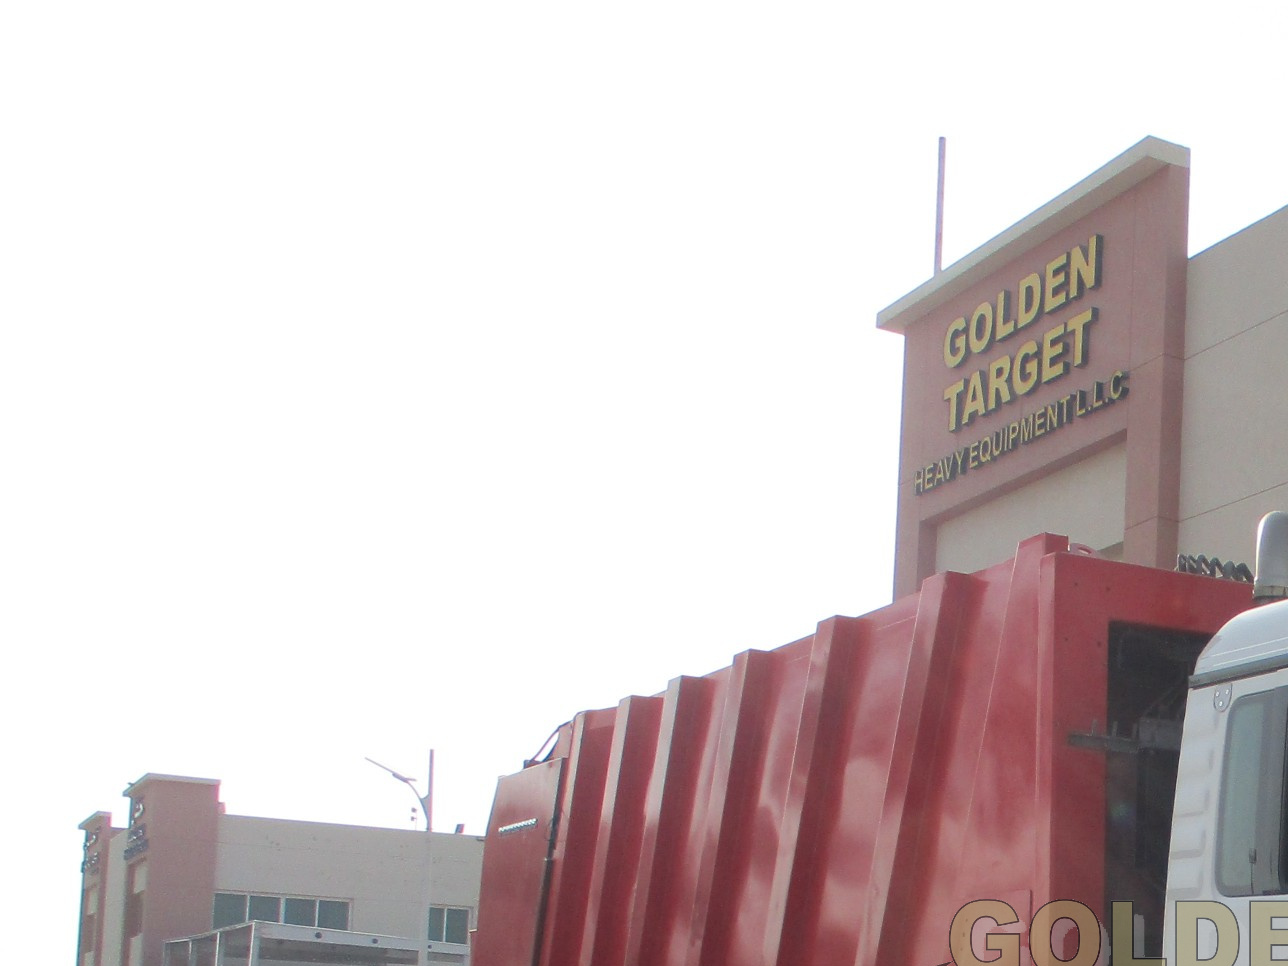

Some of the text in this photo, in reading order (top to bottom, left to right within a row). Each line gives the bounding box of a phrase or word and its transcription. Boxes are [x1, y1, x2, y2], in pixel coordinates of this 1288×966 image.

[943, 234, 1101, 369] GOLDEN
[943, 308, 1096, 433] TARGET
[913, 448, 968, 495] HEAVY
[969, 395, 1073, 469] EQUIPMENT
